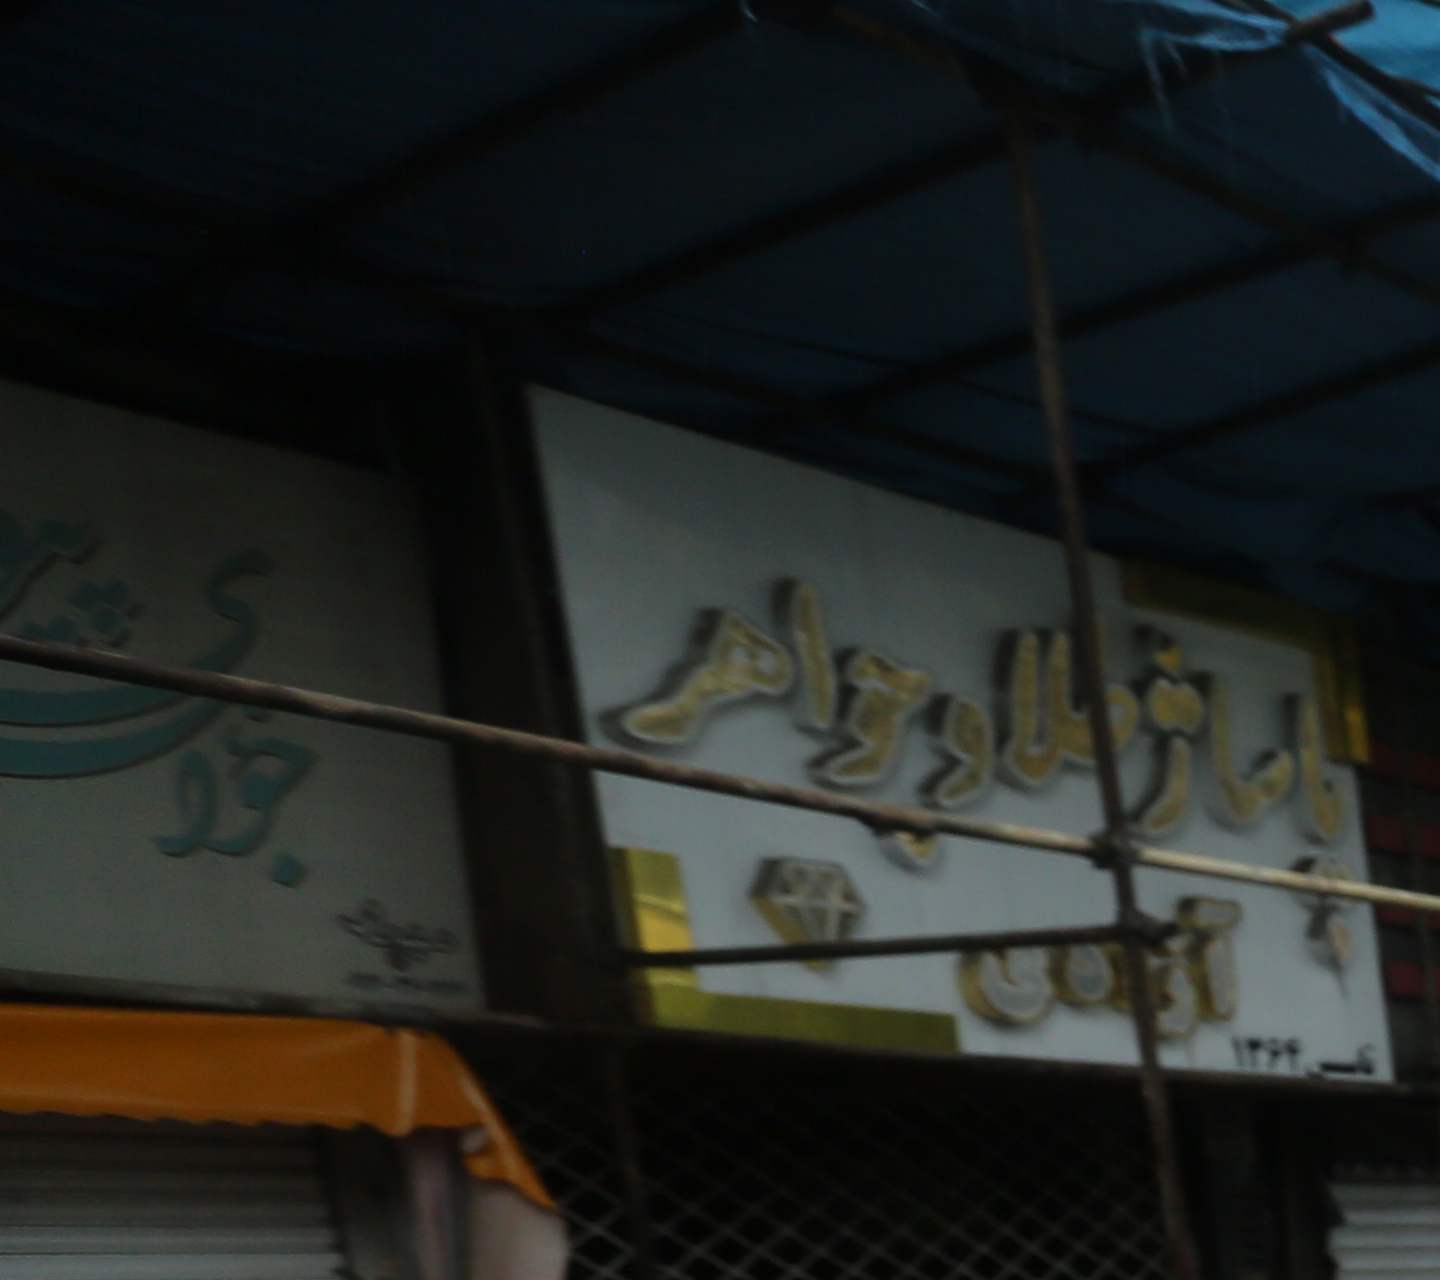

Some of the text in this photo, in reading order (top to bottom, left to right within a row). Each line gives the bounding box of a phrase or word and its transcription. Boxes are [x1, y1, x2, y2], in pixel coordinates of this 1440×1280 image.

[603, 575, 940, 870] جواهر
[923, 692, 997, 812] و
[1005, 625, 1140, 788] طلا
